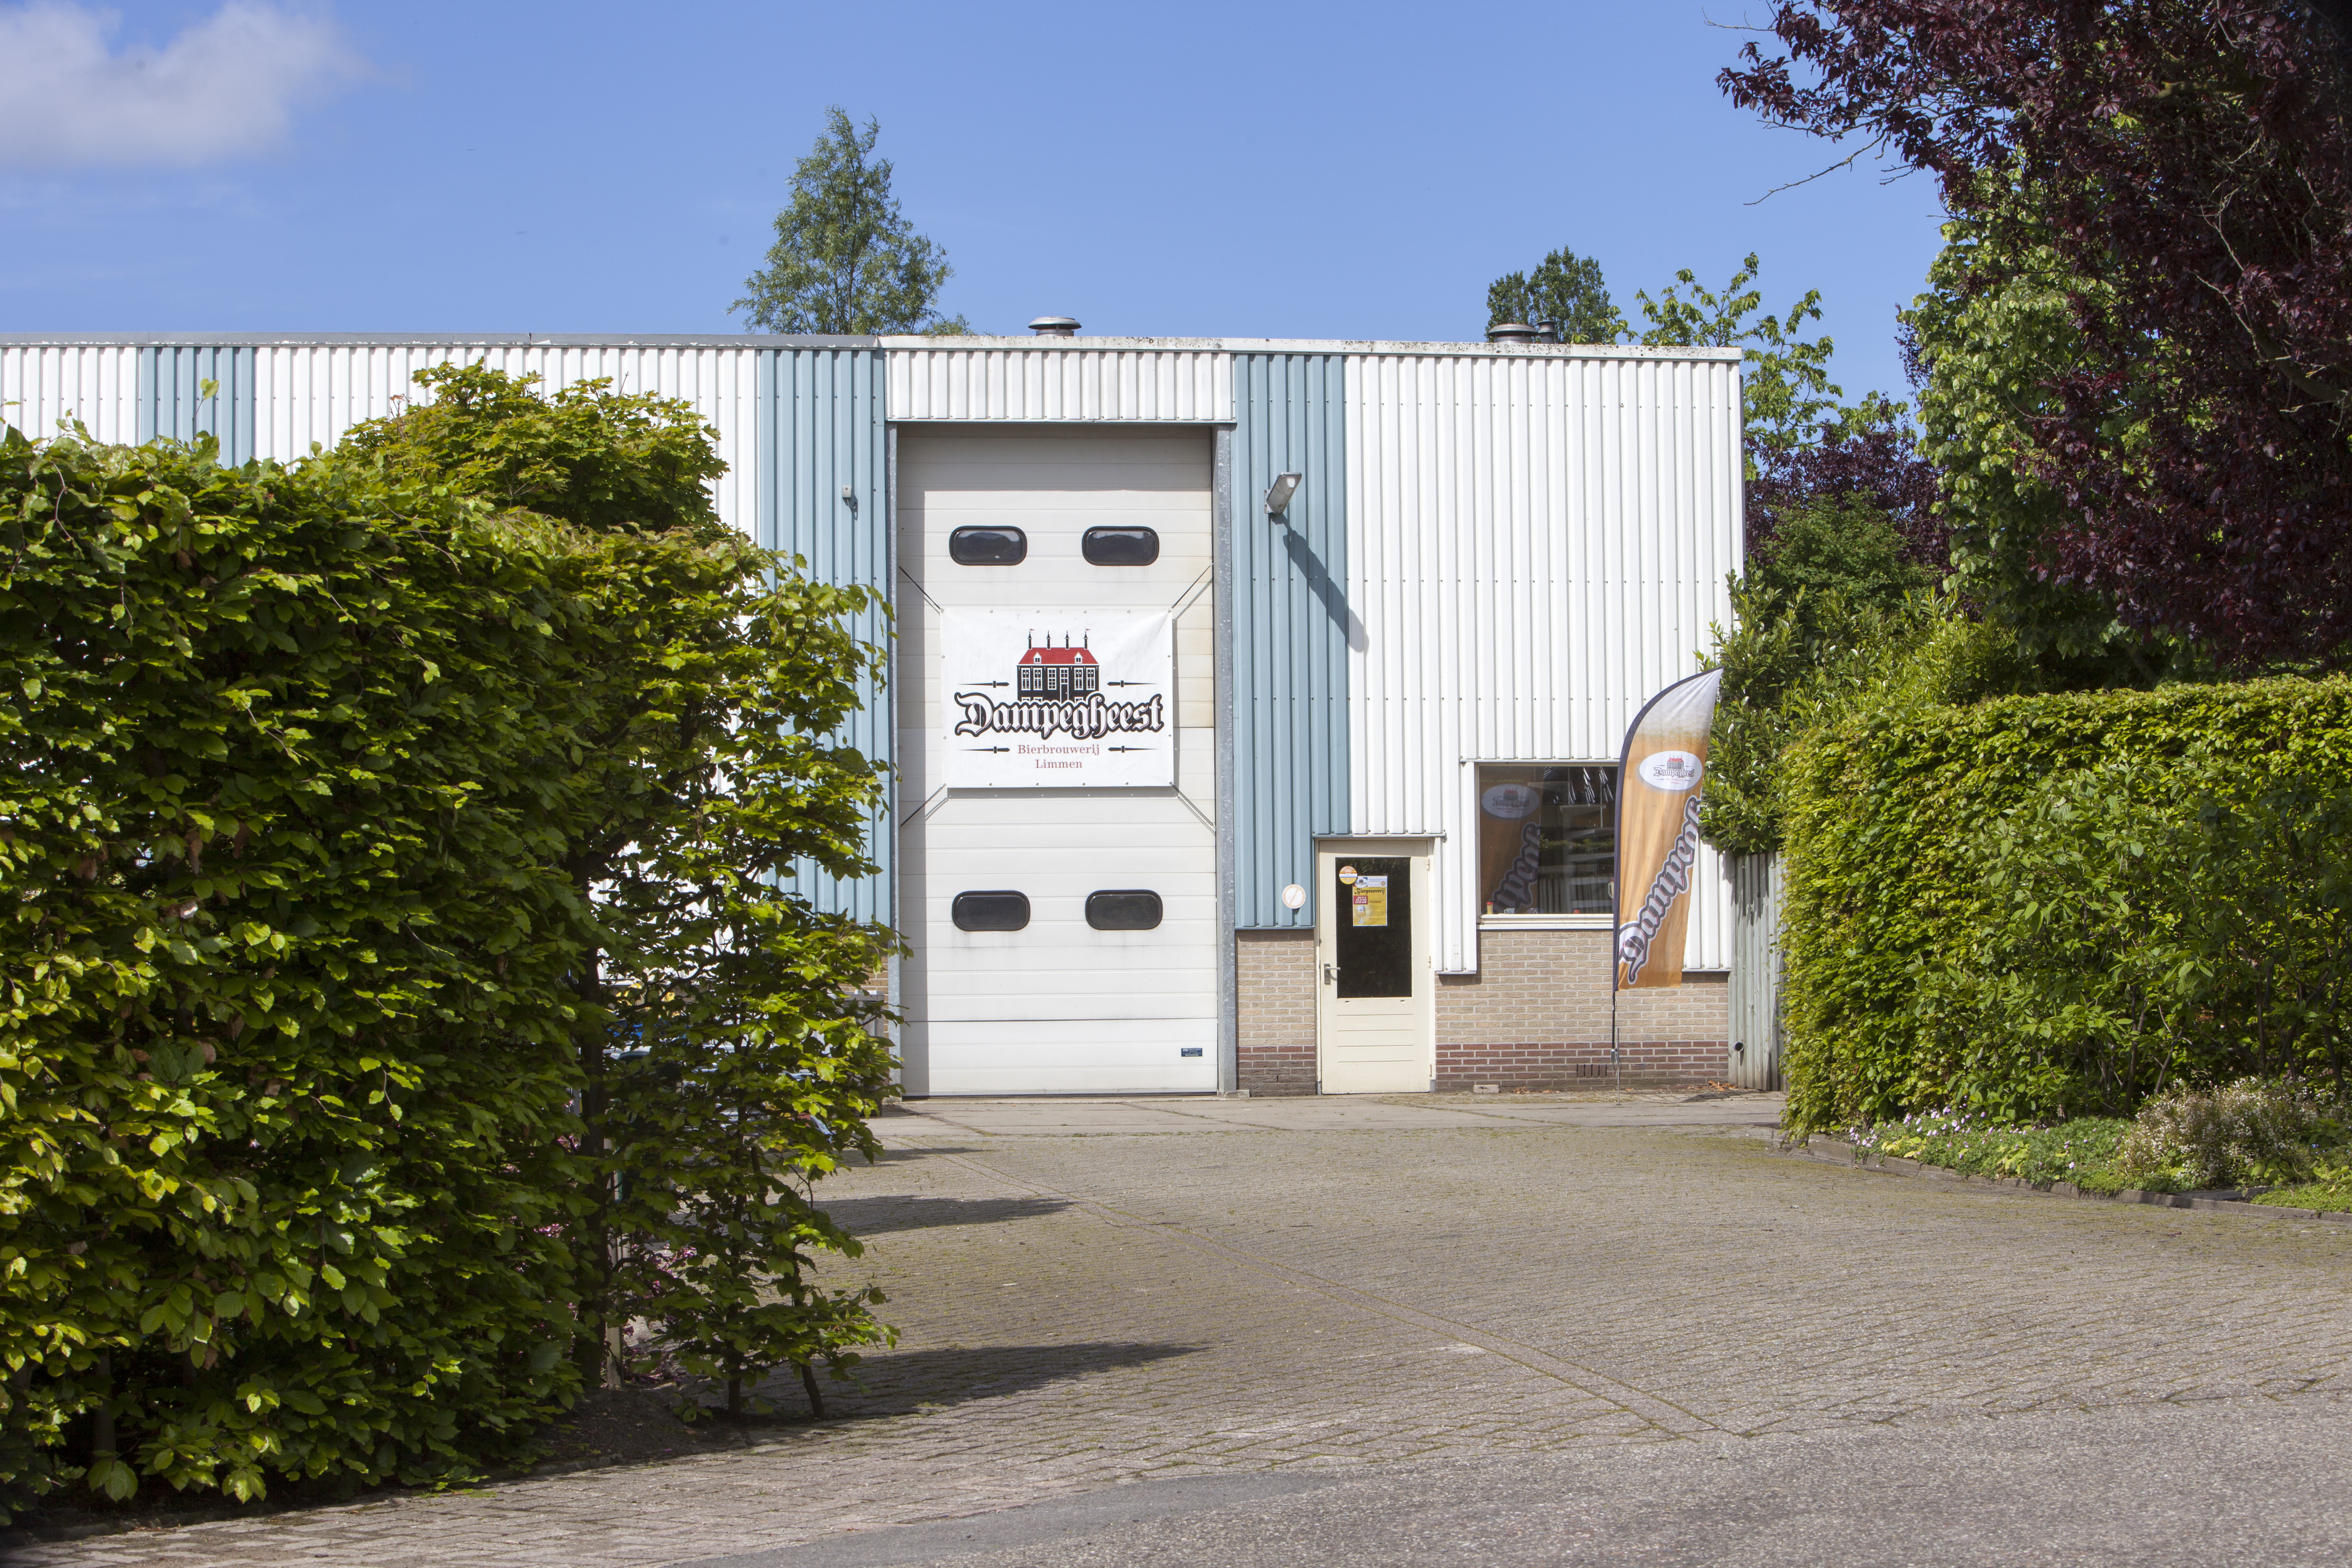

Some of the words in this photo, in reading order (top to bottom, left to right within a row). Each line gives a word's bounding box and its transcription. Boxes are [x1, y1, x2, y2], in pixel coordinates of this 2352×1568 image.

[954, 692, 1164, 740] Dampegheest
[1017, 745, 1100, 756] Bierbrouwerij
[1035, 759, 1083, 769] Limmen
[1653, 767, 1694, 778] Dampegheest
